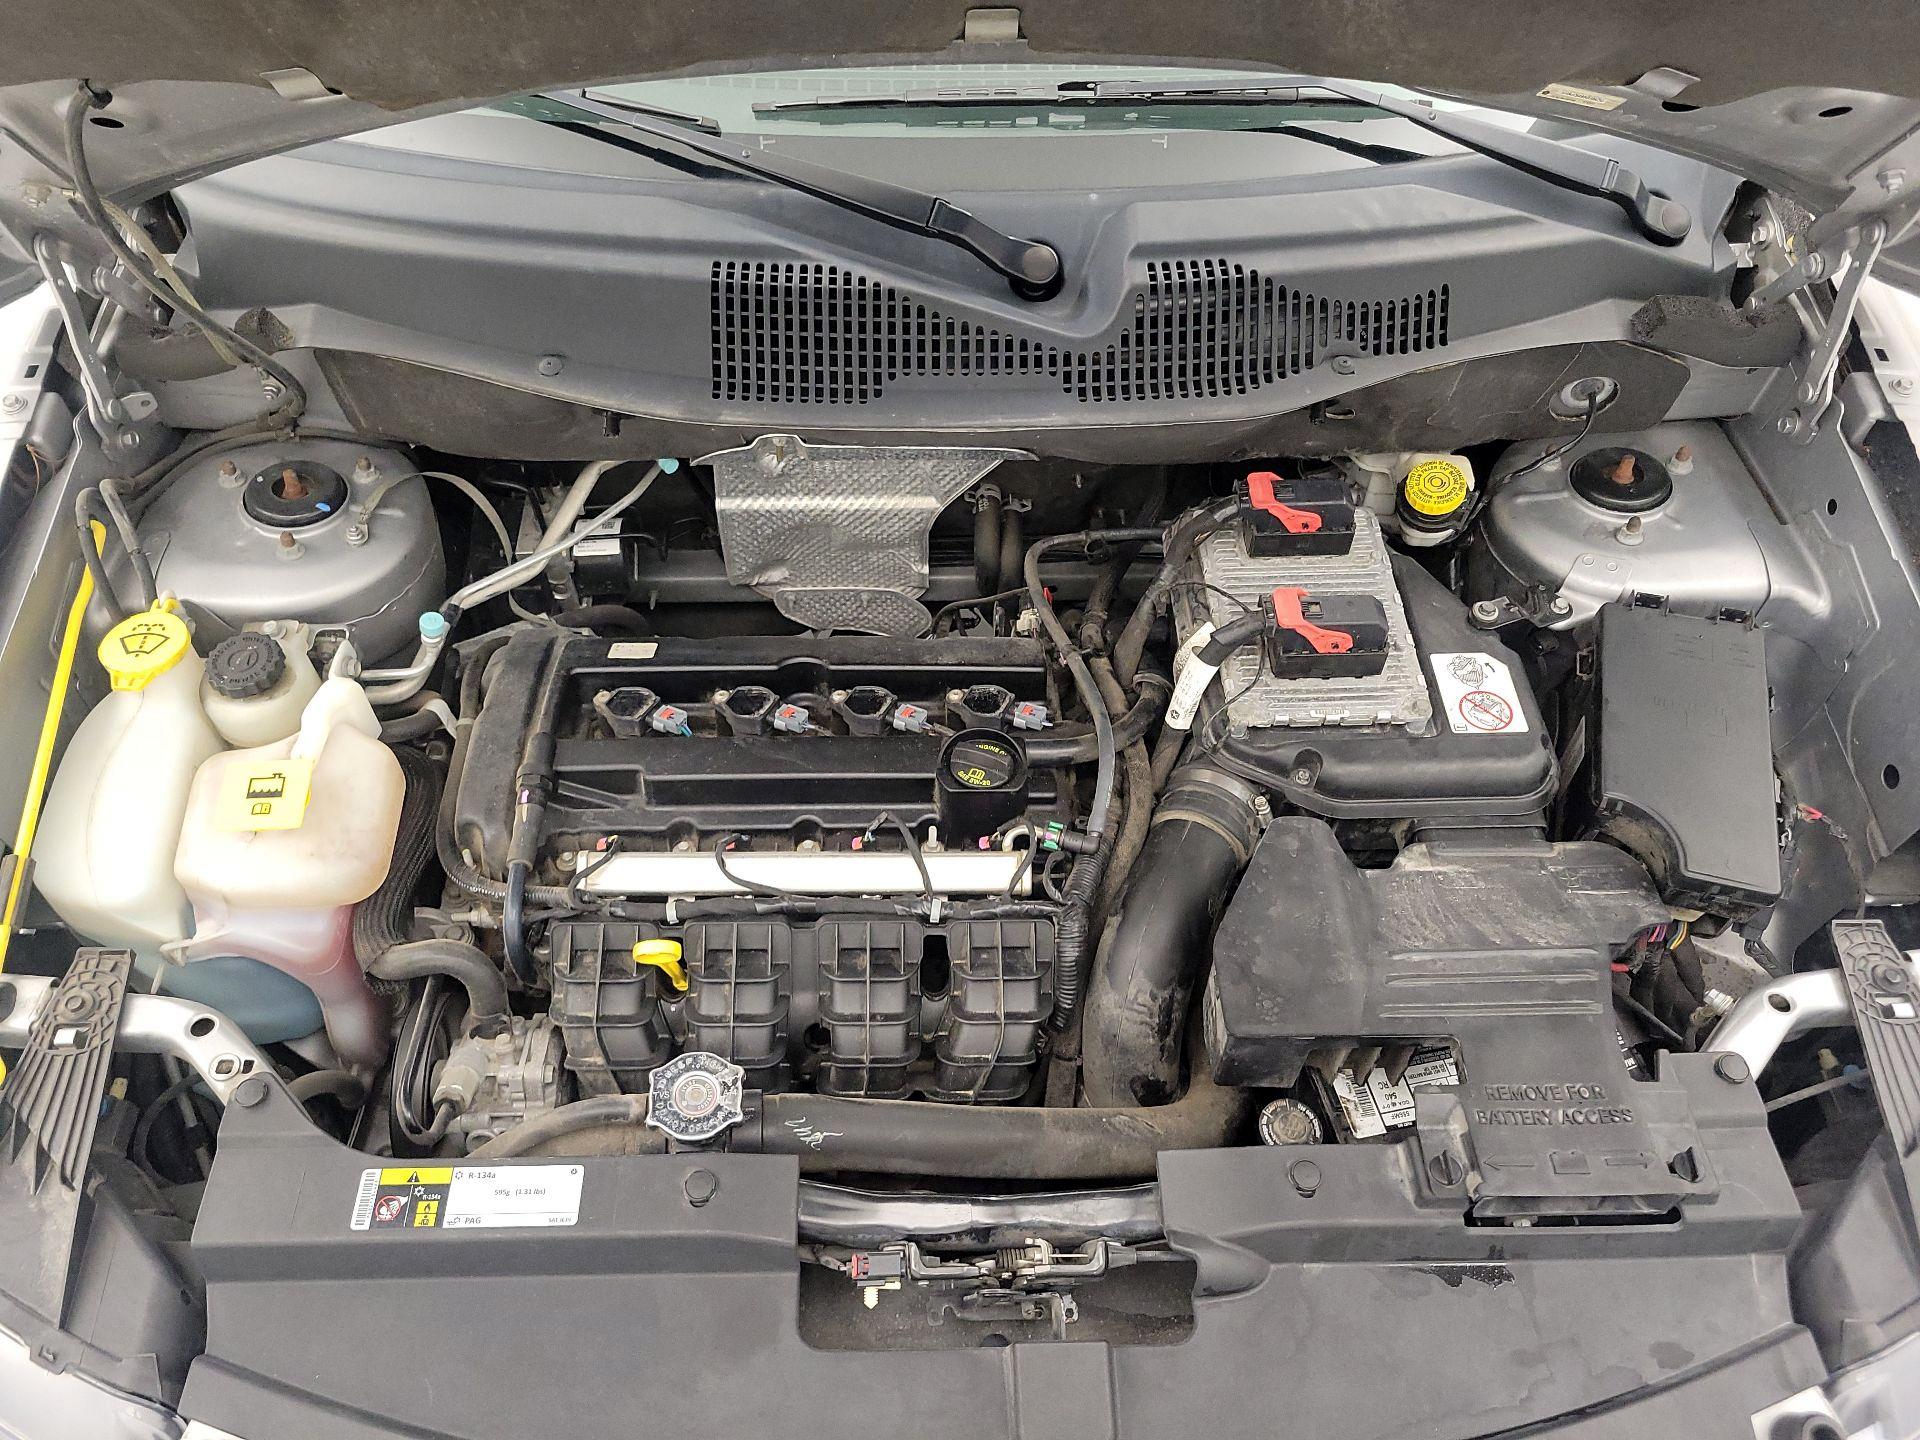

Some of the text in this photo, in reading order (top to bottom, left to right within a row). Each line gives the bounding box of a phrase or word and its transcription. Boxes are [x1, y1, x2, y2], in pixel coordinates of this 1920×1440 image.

[1378, 1081, 1389, 1090] RC
[653, 1091, 670, 1101] TVS
[1484, 1083, 1606, 1101] REMOVE FOR
[1475, 1108, 1633, 1126] BATTERY ACCESS
[494, 1188, 546, 1197] 595g (1.31 lbs)
[464, 1216, 482, 1225] PAG
